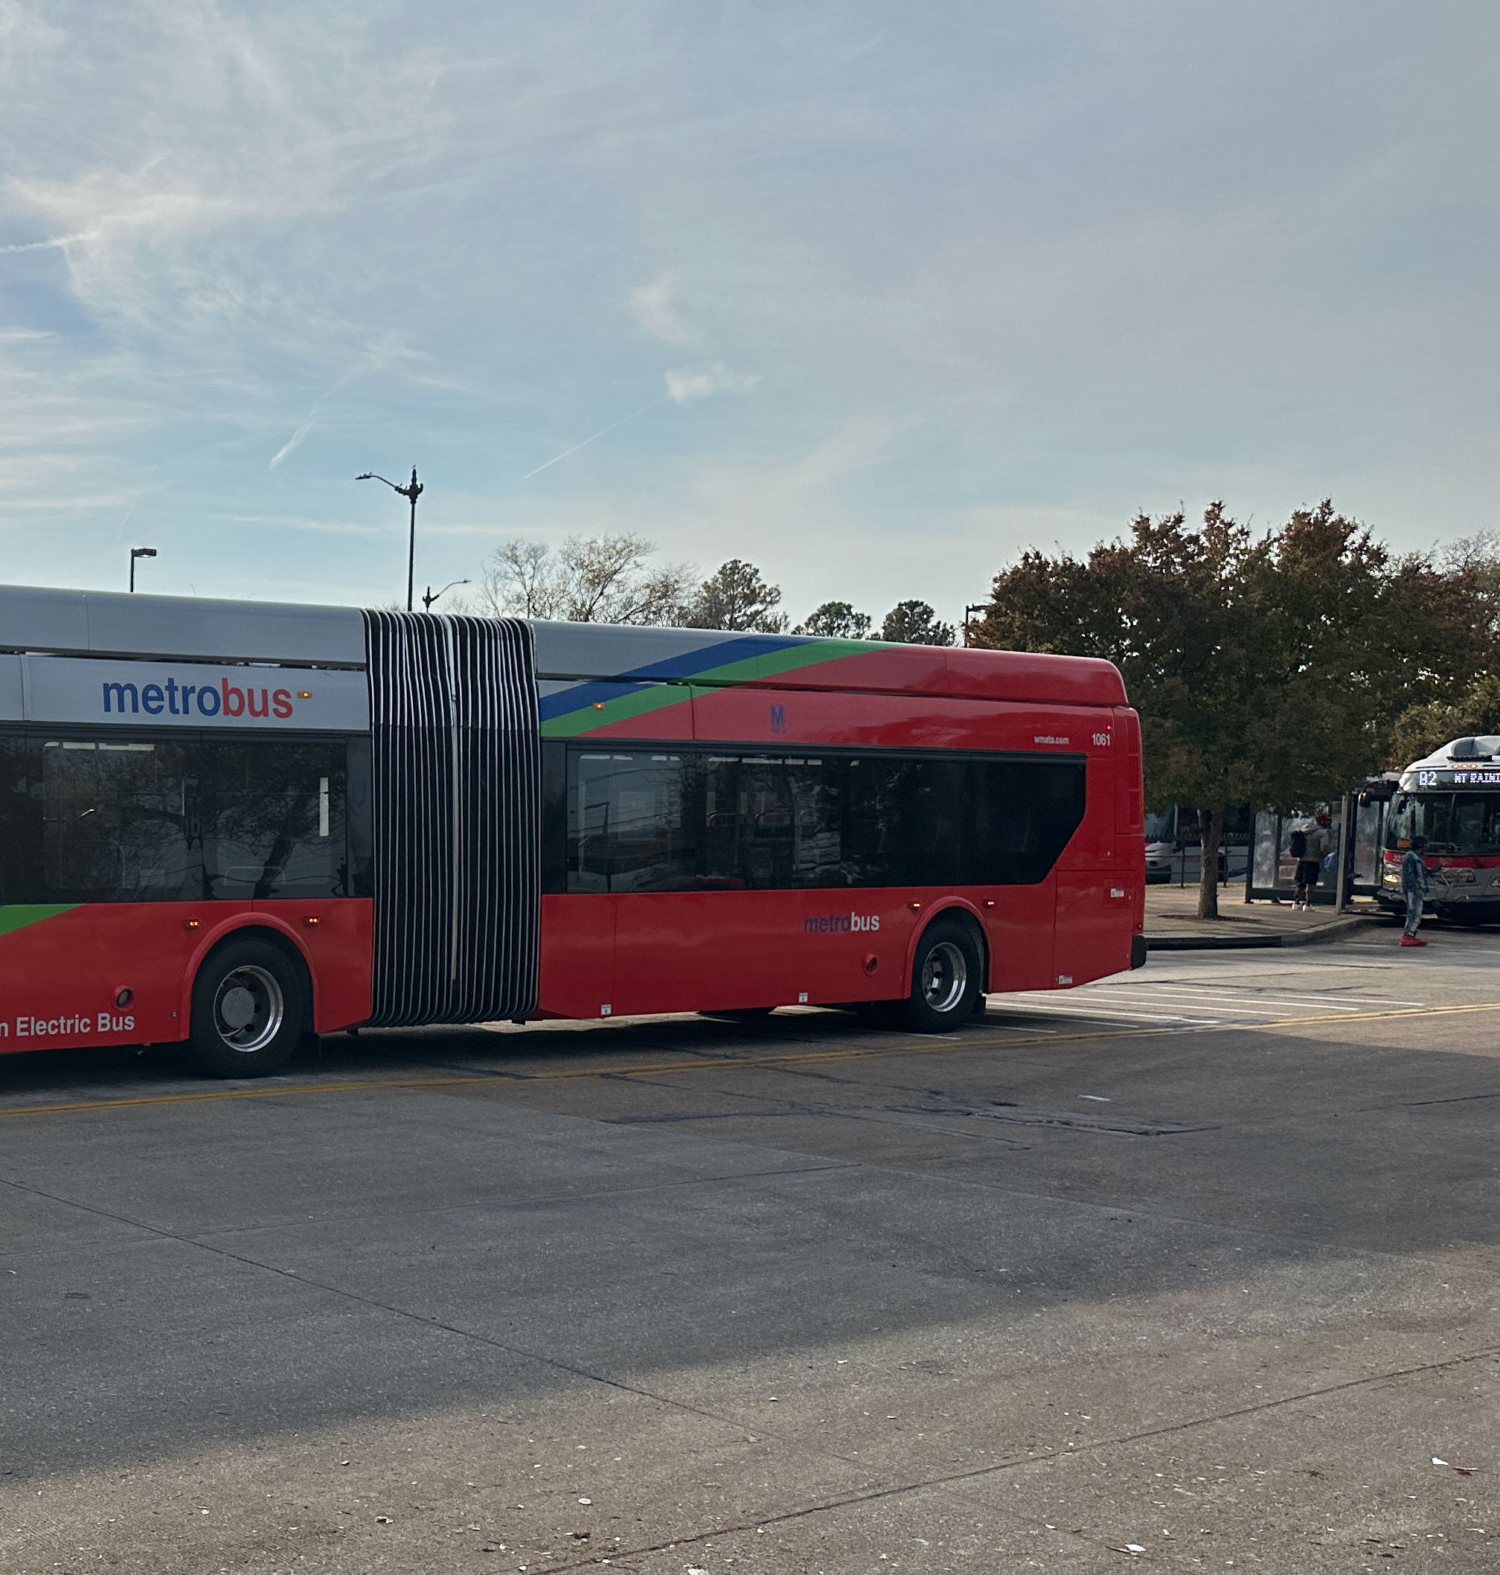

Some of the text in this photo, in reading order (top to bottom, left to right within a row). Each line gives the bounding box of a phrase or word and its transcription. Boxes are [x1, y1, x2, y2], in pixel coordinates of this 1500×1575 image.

[102, 677, 293, 719] metrobus
[1033, 735, 1070, 745] wmata.com
[1091, 733, 1111, 747] 1061
[804, 911, 880, 933] metrobus
[16, 1013, 91, 1037] Electric
[97, 1012, 135, 1032] Bus
